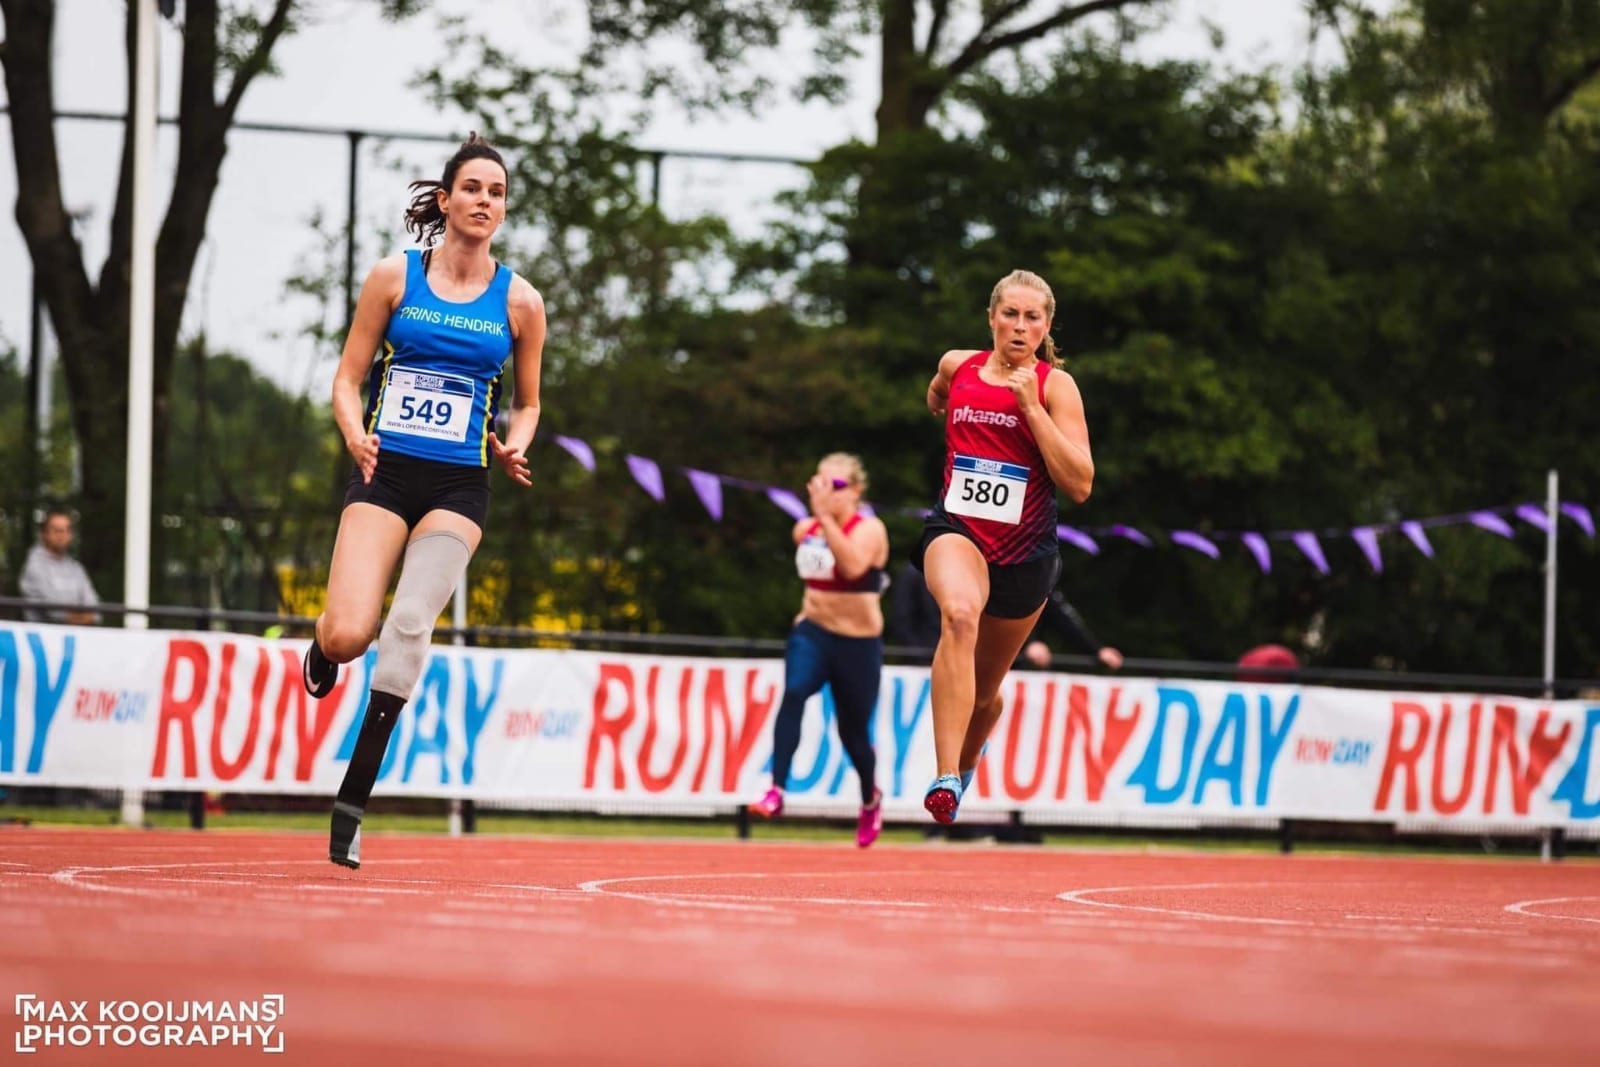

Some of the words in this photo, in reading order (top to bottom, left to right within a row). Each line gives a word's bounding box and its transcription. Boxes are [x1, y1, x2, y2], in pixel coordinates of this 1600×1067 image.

[400, 306, 441, 324] PRINS
[443, 314, 504, 337] HENDRIK
[399, 395, 453, 426] 549
[952, 405, 1019, 428] phanos
[961, 477, 1010, 507] 580
